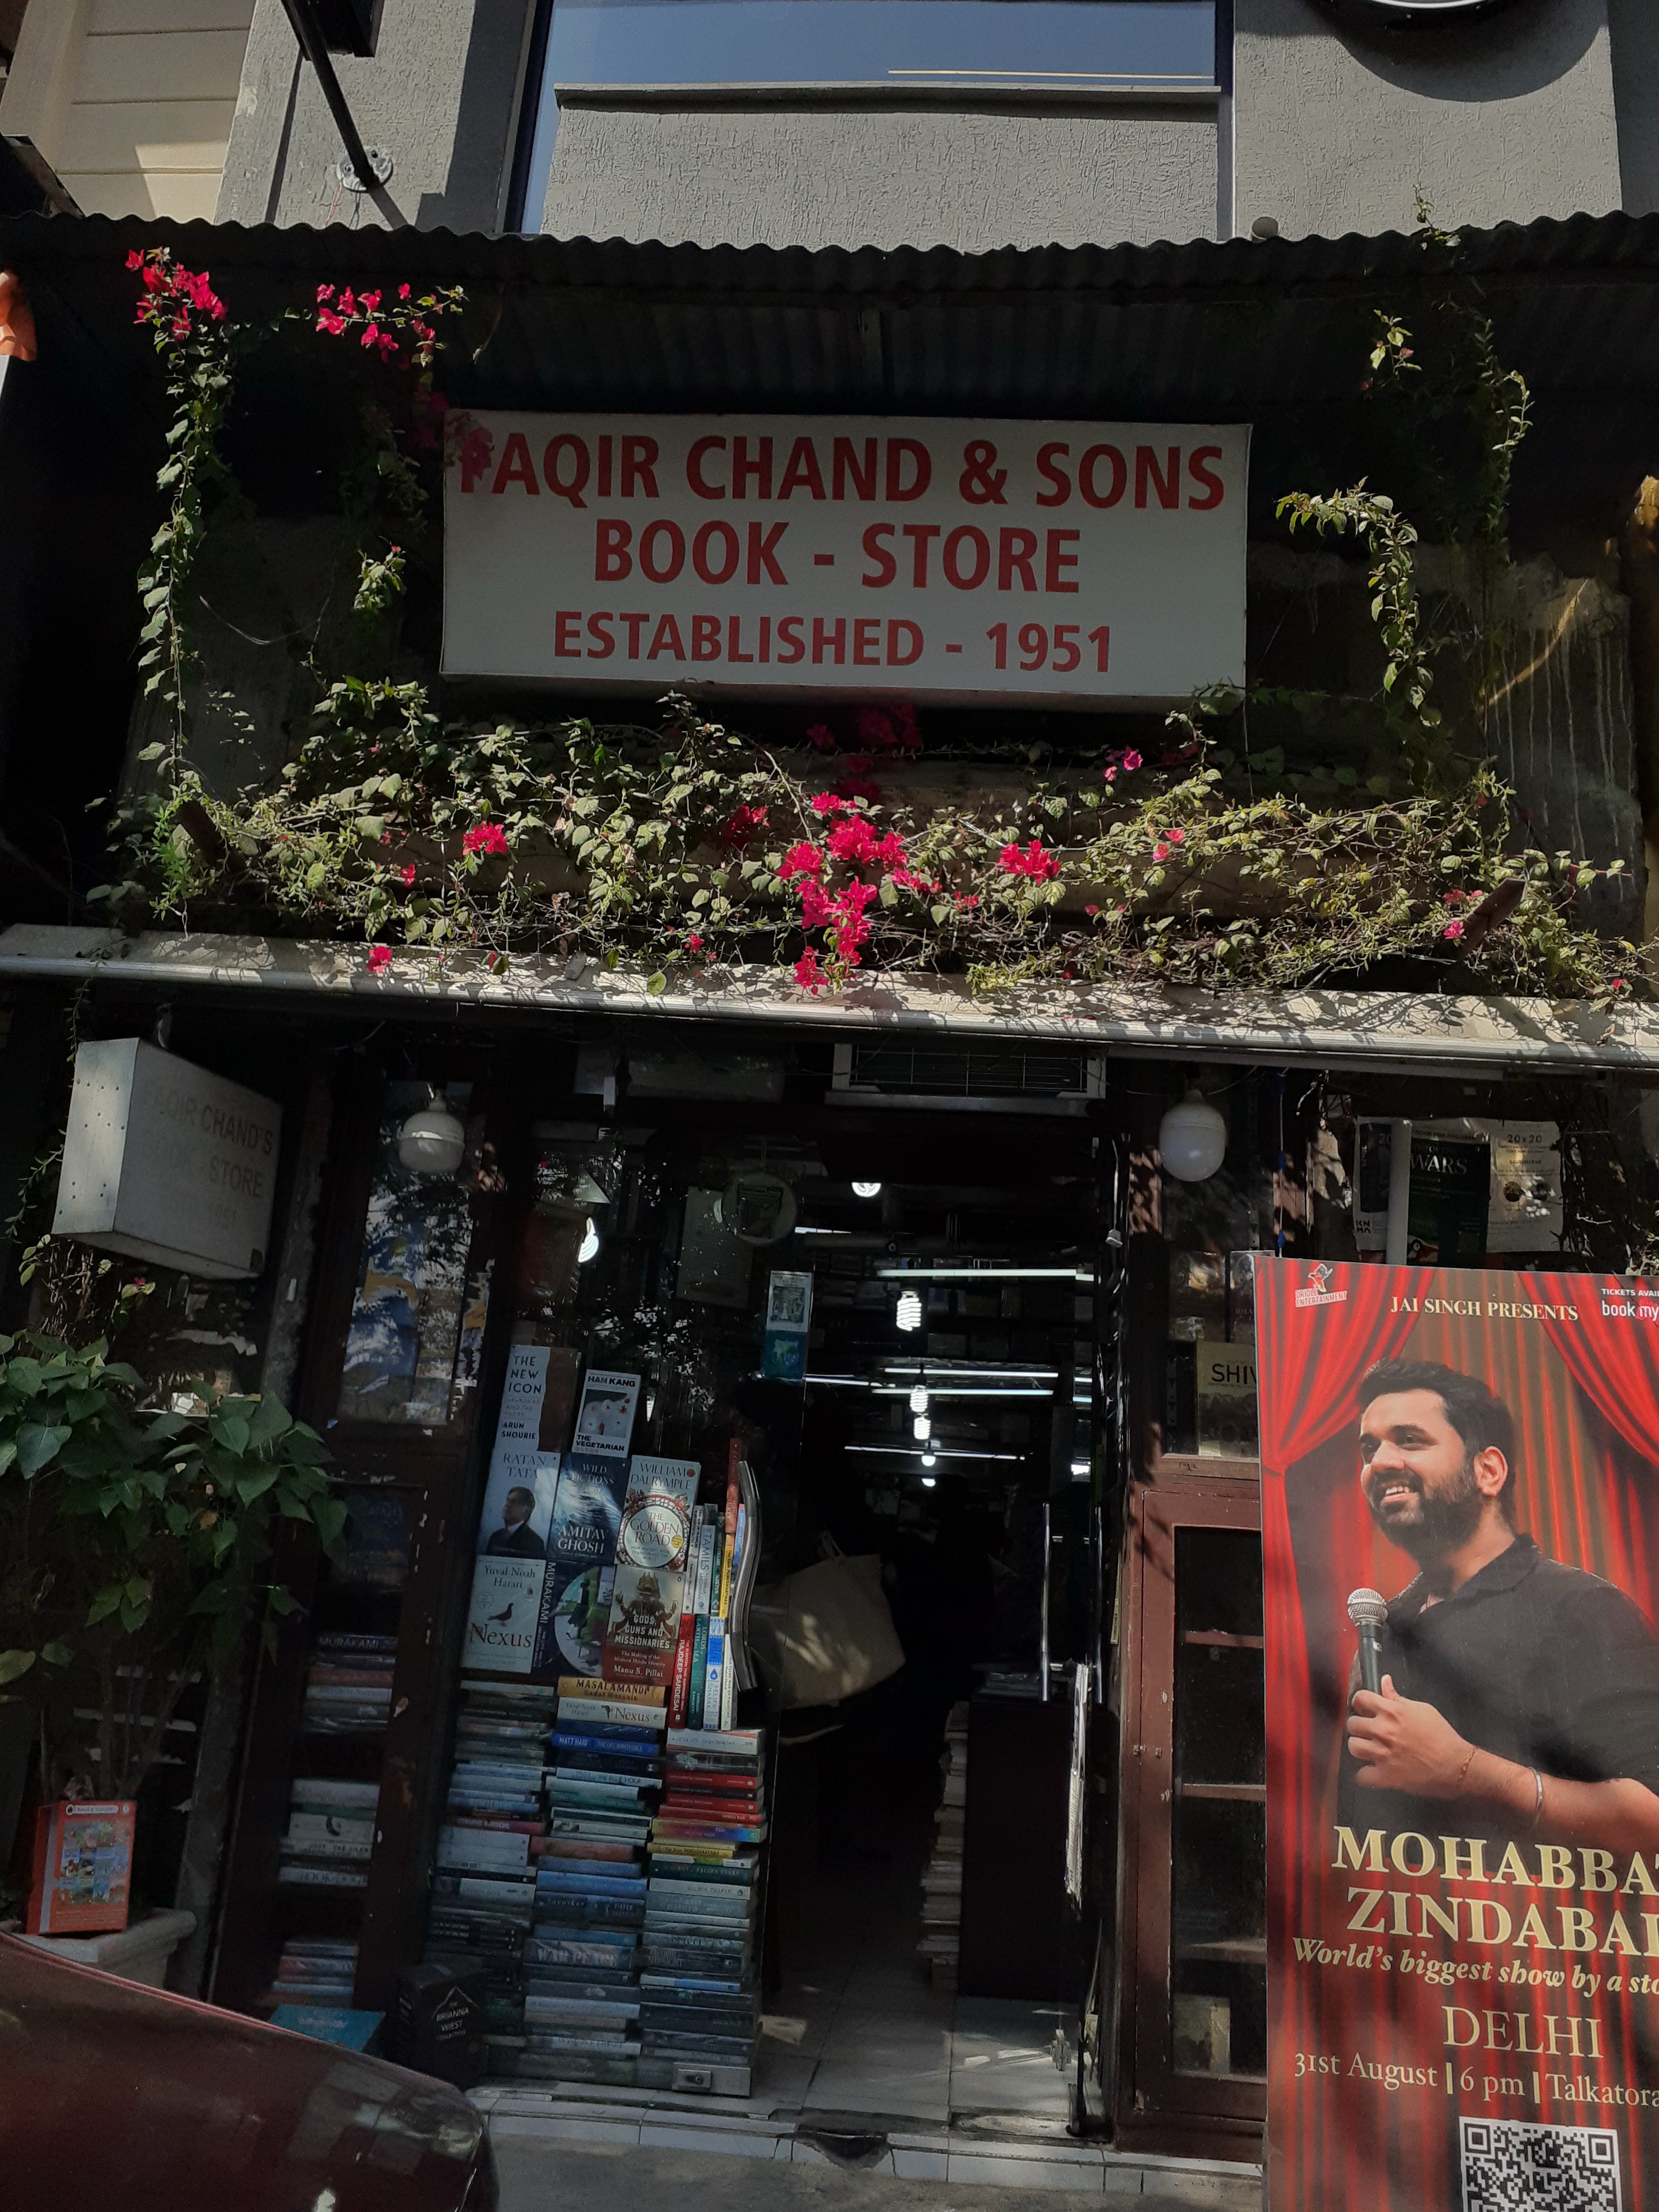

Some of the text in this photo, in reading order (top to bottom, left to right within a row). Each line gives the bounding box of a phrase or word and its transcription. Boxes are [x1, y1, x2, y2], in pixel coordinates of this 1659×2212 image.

[686, 435, 932, 503] CHAND
[959, 438, 1007, 505] &
[1035, 443, 1225, 510] SONS
[594, 519, 789, 585] BOOK
[861, 524, 1081, 594] STORE
[553, 611, 925, 666] ESTABLISHED
[987, 623, 1111, 673] 1951
[1410, 1154, 1468, 1175] WARS
[1296, 1288, 1318, 1299] ORIOLE
[1601, 1288, 1636, 1296] TICKETS
[1296, 1292, 1347, 1307] ENTERTAINMENT
[1390, 1296, 1579, 1322] JAI SINGH PRESENTS
[514, 1355, 536, 1366] THE
[511, 1369, 539, 1380] NEW
[588, 1376, 636, 1387] HAN KANG
[508, 1382, 542, 1394] ICON
[502, 1431, 536, 1440] SHOURIE
[575, 1440, 625, 1452] VEGETARIAN
[503, 1453, 547, 1466] RATAN
[507, 1467, 538, 1479] TATA
[582, 1463, 607, 1474] WILD
[640, 1462, 686, 1477] WILLIAM
[567, 1473, 615, 1485] FICTIONS
[630, 1474, 691, 1490] DALRYMPLE
[648, 1512, 664, 1521] THE
[557, 1525, 609, 1541] AMITAV
[630, 1518, 679, 1535] GOLDEN
[557, 1537, 606, 1554] GHOSH
[634, 1531, 670, 1546] ROAD
[700, 1534, 712, 1571] TAMILS
[484, 1565, 536, 1579] Yuval Noah
[494, 1577, 523, 1589] Harari
[539, 1561, 557, 1624] MURAKAMI
[633, 1614, 656, 1626] GODS,
[470, 1621, 533, 1648] Nexus
[624, 1625, 663, 1637] GUNS AND
[694, 1618, 702, 1642] EARTH
[319, 1636, 379, 1648] MURAKAMI
[615, 1635, 671, 1649] MISSIONARIES
[631, 1652, 647, 1660] Making
[614, 1665, 664, 1678] Manu S. Pillai
[672, 1640, 685, 1711] RAJDEEP SARDESAI
[615, 1707, 651, 1722] Nexus
[559, 1737, 574, 1745] MATT
[574, 1738, 588, 1747] HAIG
[1331, 1825, 1659, 1897] MOHABBA
[1292, 1937, 1393, 1972] World's
[1399, 1950, 1492, 1985] biggest
[1497, 1959, 1565, 1989] show
[1571, 1964, 1601, 1997] by
[1608, 1976, 1623, 1992] a
[1441, 2005, 1605, 2058] DELHI
[1294, 2052, 1341, 2078] 31st
[1346, 2052, 1439, 2090] August
[1460, 2066, 1475, 2091] 6
[1483, 2074, 1526, 2103] pm
